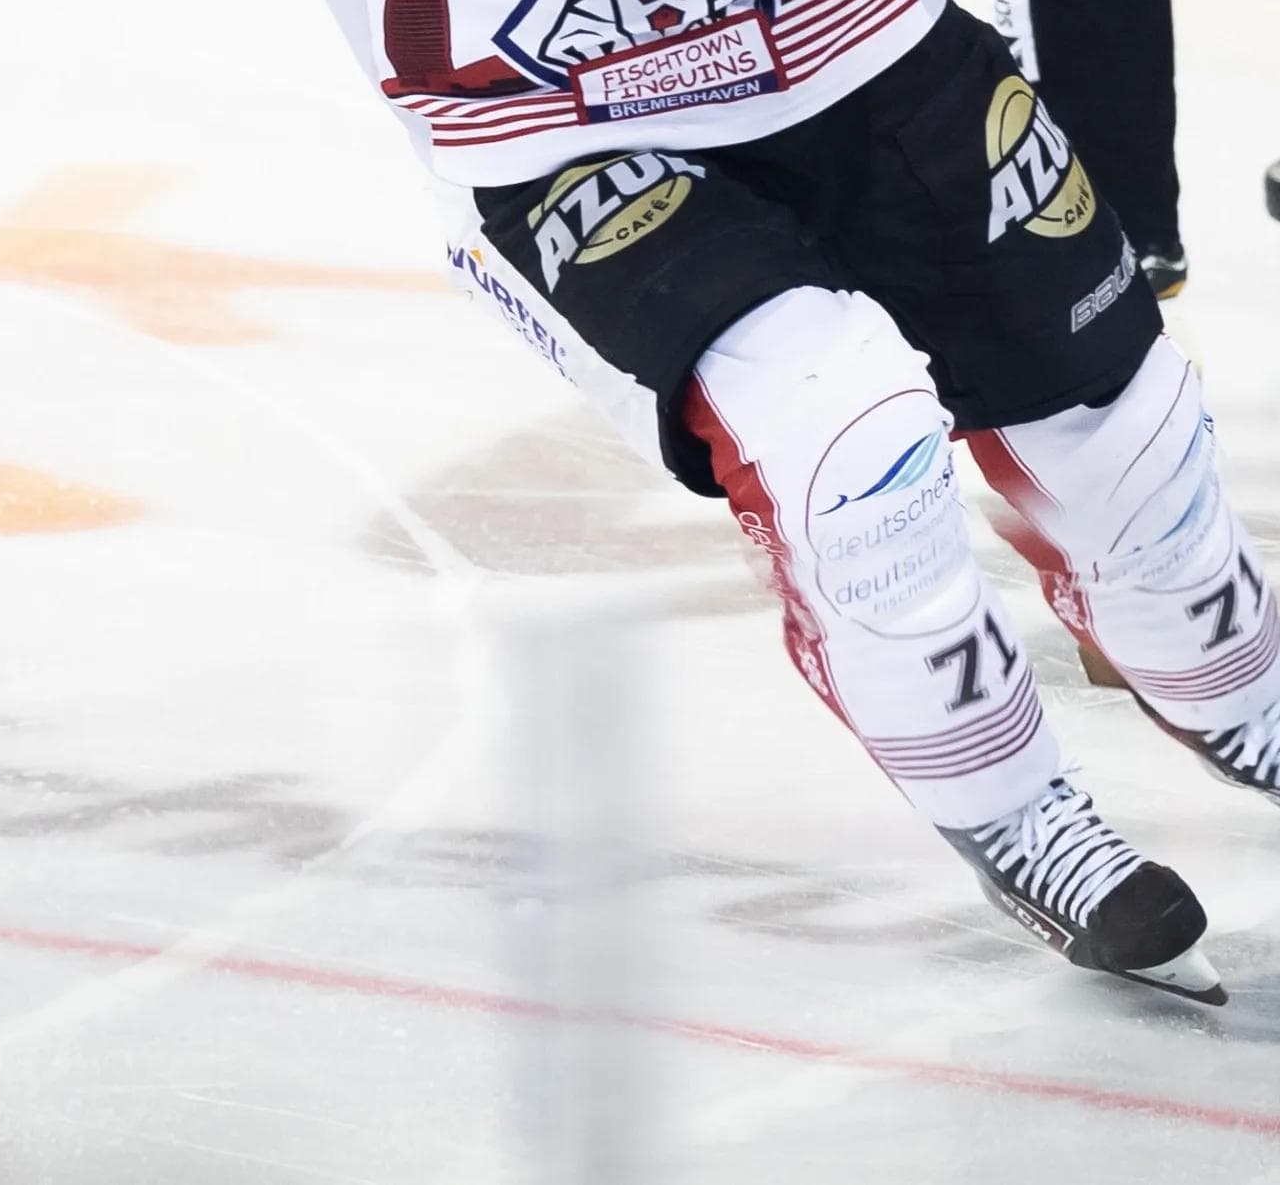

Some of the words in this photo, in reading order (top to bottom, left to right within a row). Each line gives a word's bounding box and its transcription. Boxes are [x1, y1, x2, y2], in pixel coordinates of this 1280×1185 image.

[601, 29, 744, 89] FISCHTOWN
[609, 80, 761, 119] BREMERHAVEN
[987, 96, 1070, 244] AZU
[1184, 545, 1264, 653] 71
[924, 608, 1018, 714] 71
